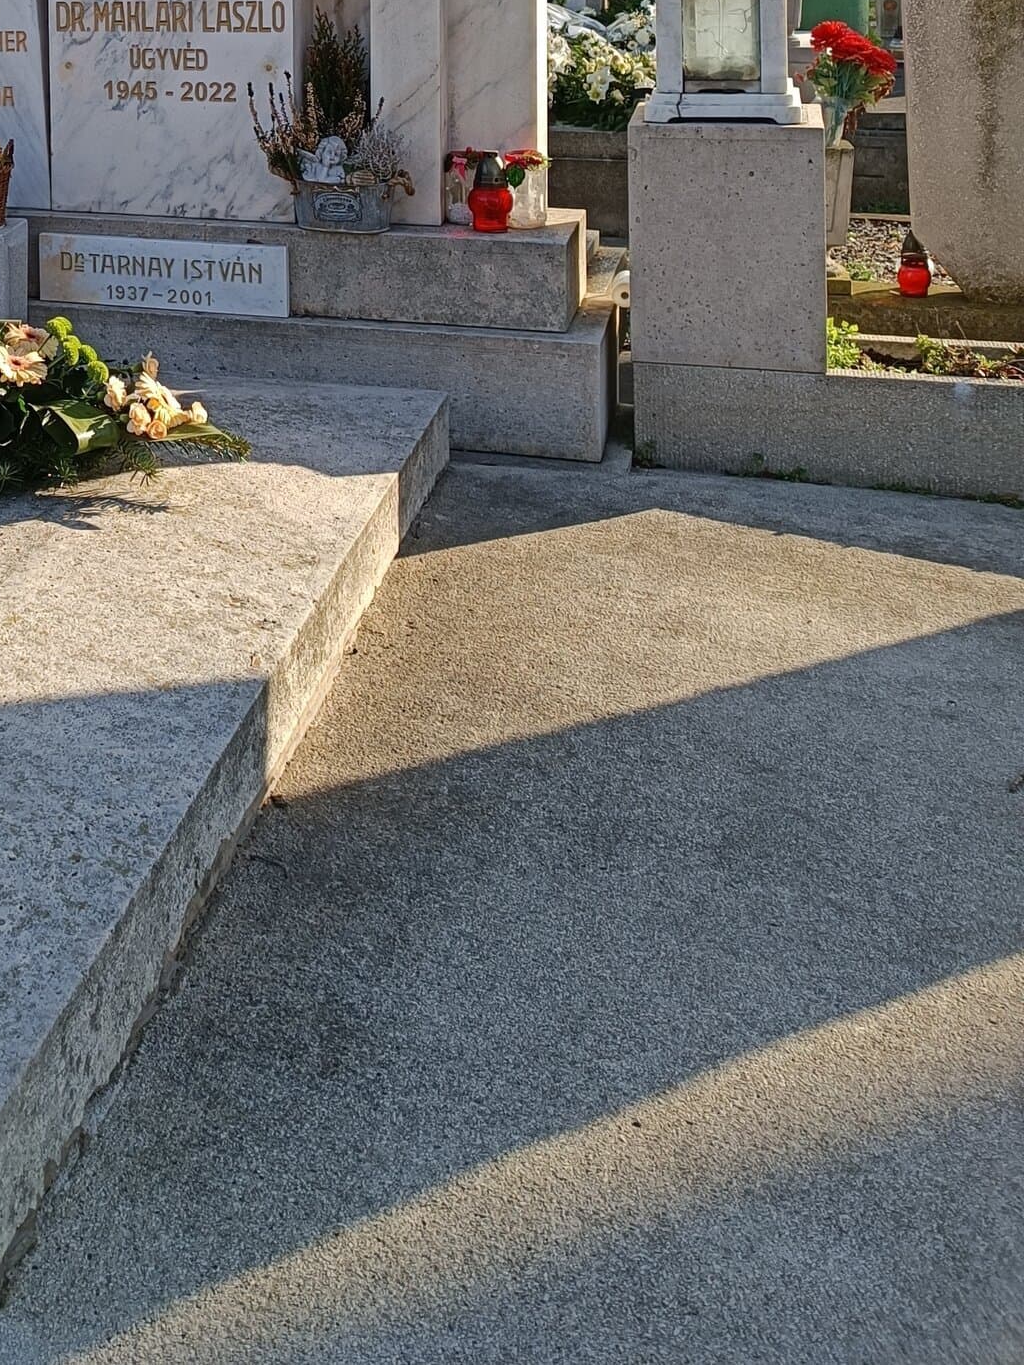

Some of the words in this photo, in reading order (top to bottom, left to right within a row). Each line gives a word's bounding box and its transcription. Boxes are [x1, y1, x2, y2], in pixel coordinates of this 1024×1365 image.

[129, 42, 208, 71] ÜGYVÉD
[103, 80, 158, 101] 1945
[180, 81, 237, 102] 2022
[89, 253, 175, 280] TARNAY
[184, 256, 263, 284] ISTVÁN
[106, 284, 149, 301] 1937
[167, 289, 212, 306] 2001
